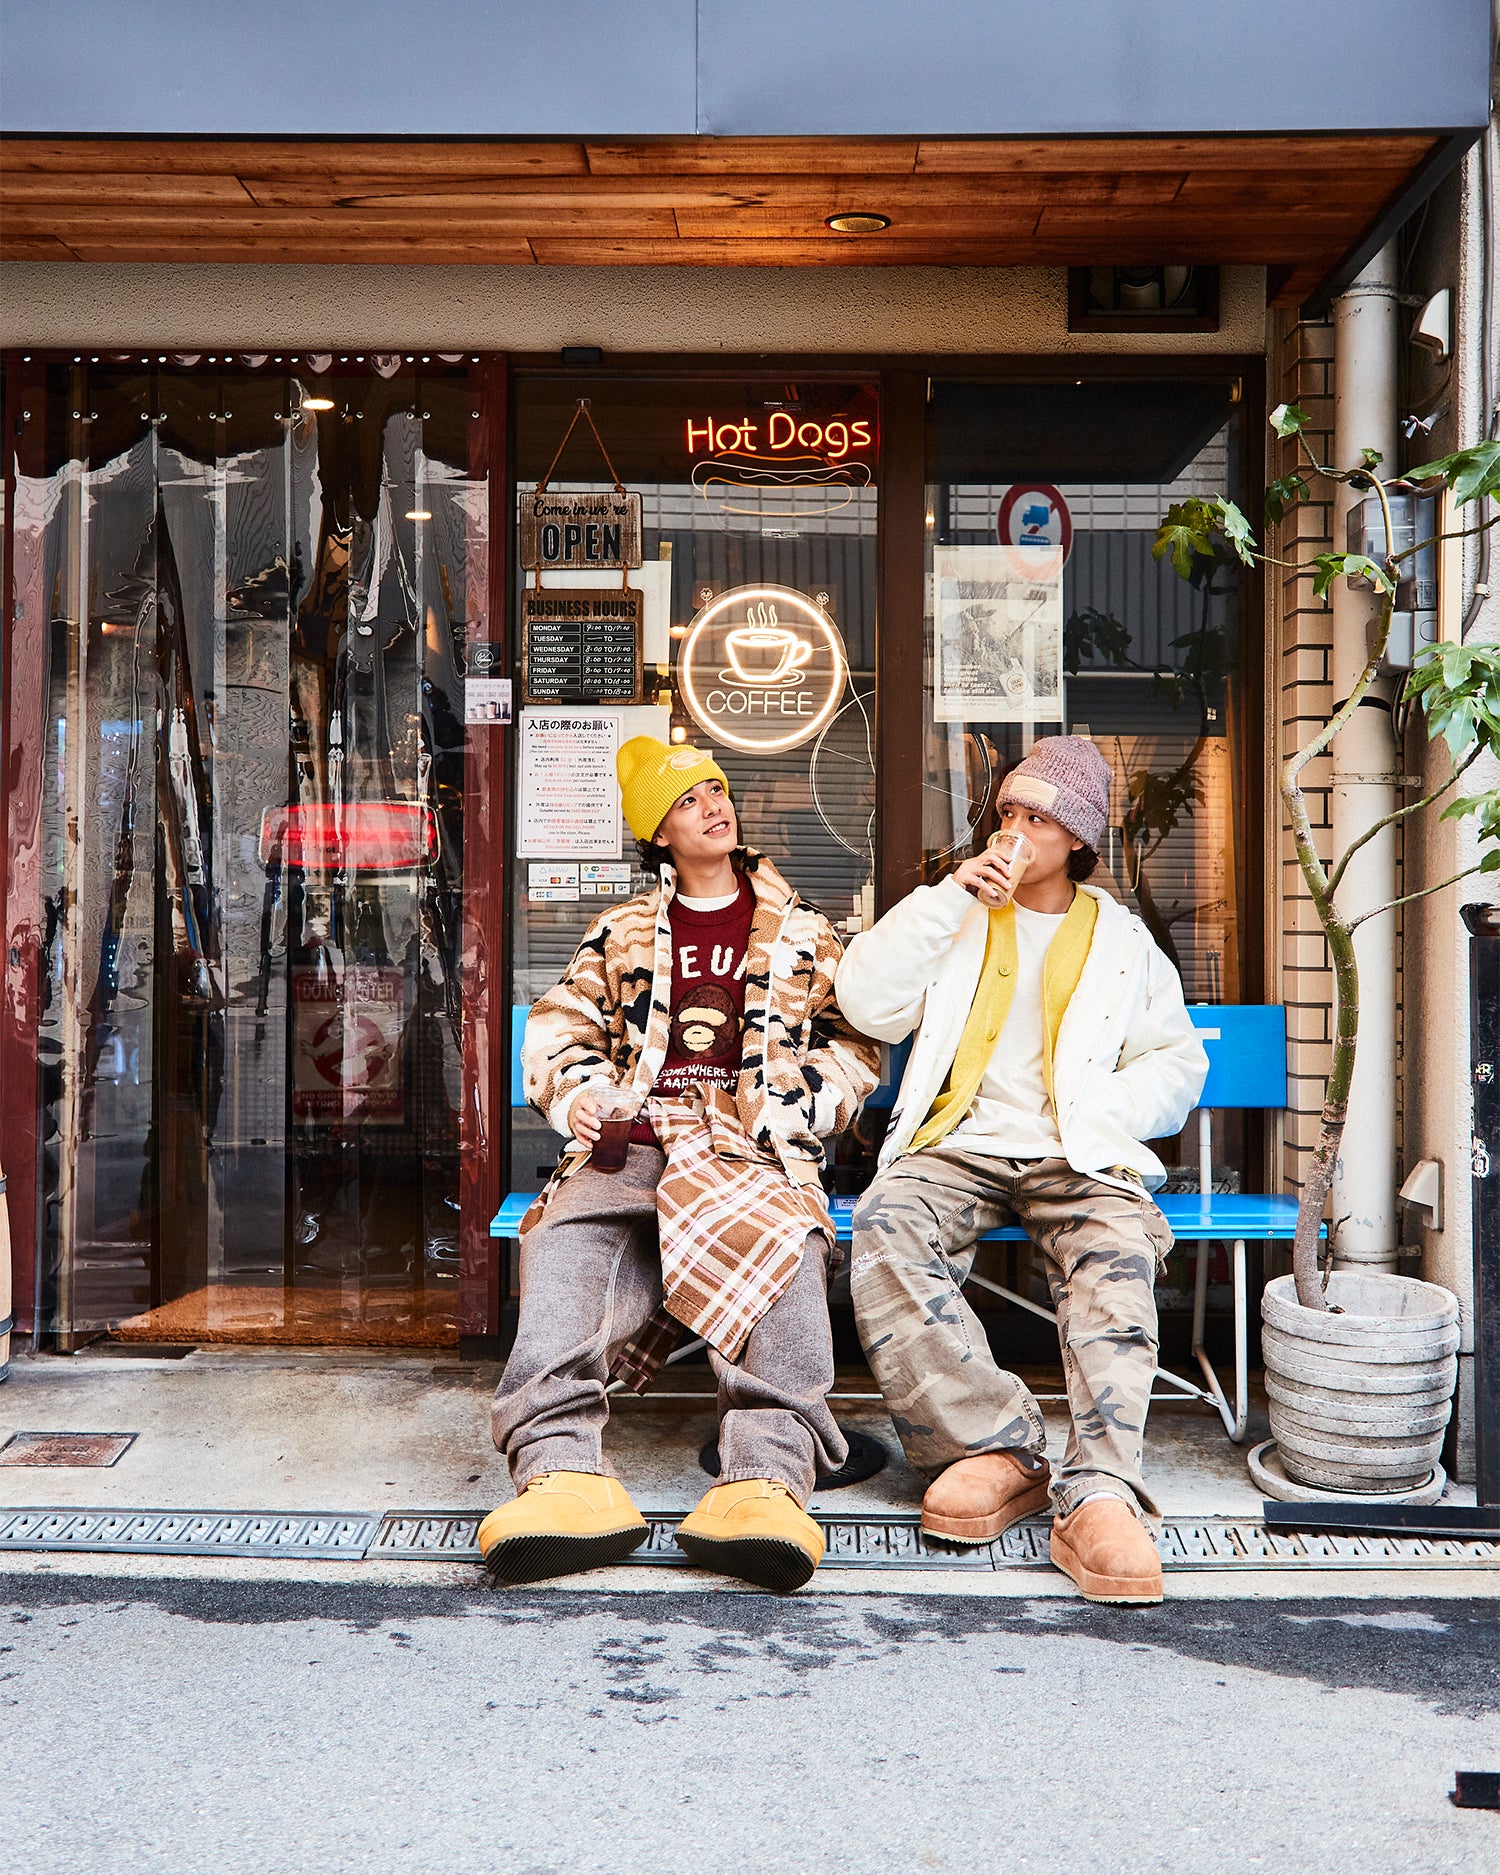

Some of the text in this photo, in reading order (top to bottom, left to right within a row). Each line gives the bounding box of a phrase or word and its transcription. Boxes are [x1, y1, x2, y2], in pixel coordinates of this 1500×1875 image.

[687, 412, 872, 457] Hot Dogs
[533, 499, 628, 518] Come in we're
[542, 522, 621, 562] OPEN
[528, 600, 636, 616] BUSINESS HOURS
[706, 690, 814, 716] COFFEE
[528, 720, 613, 730] 入店の際のお願い
[659, 1064, 728, 1078] SOMEWHERE
